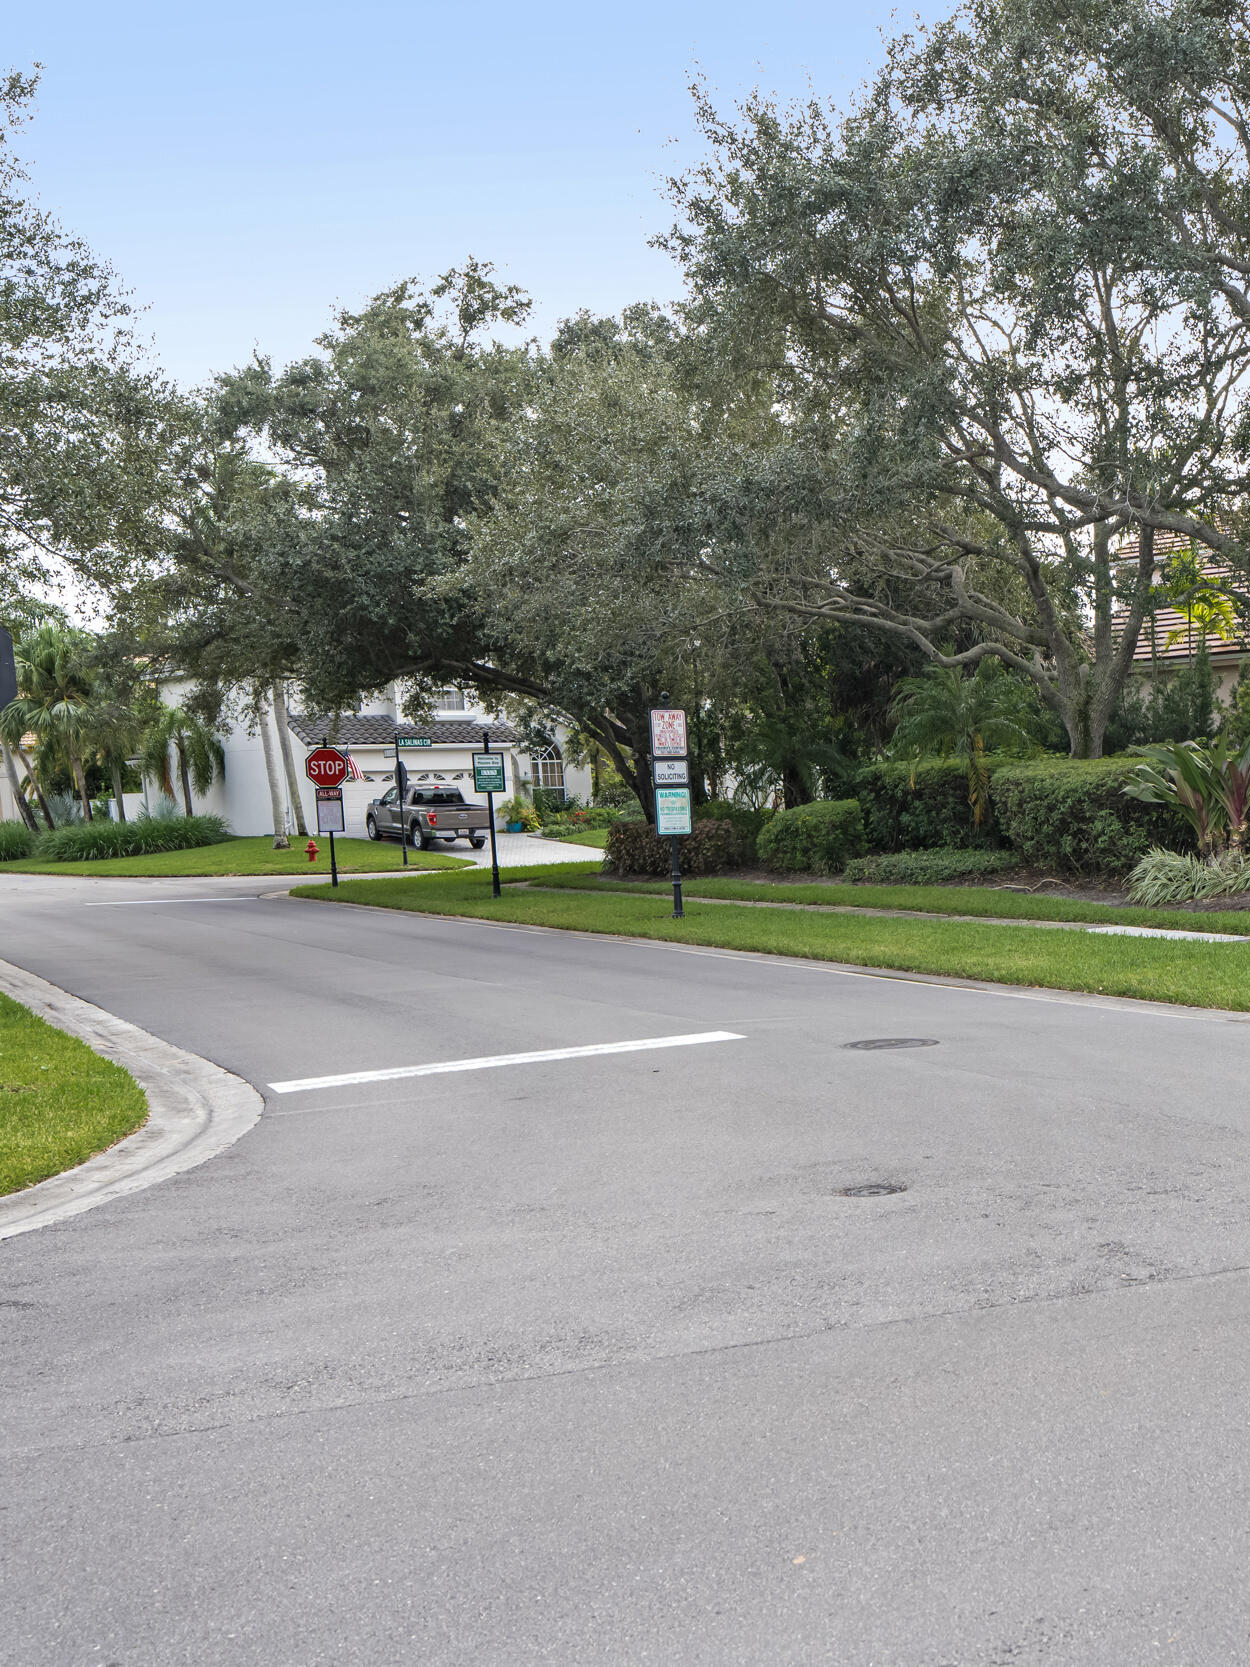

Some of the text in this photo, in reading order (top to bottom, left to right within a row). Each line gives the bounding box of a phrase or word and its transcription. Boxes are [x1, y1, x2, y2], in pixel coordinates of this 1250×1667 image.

[654, 713, 681, 721] TOW AWAY
[661, 721, 676, 730] ZONE
[398, 738, 405, 746] LA
[310, 760, 344, 775] STOP
[657, 773, 686, 781] SOLICITING
